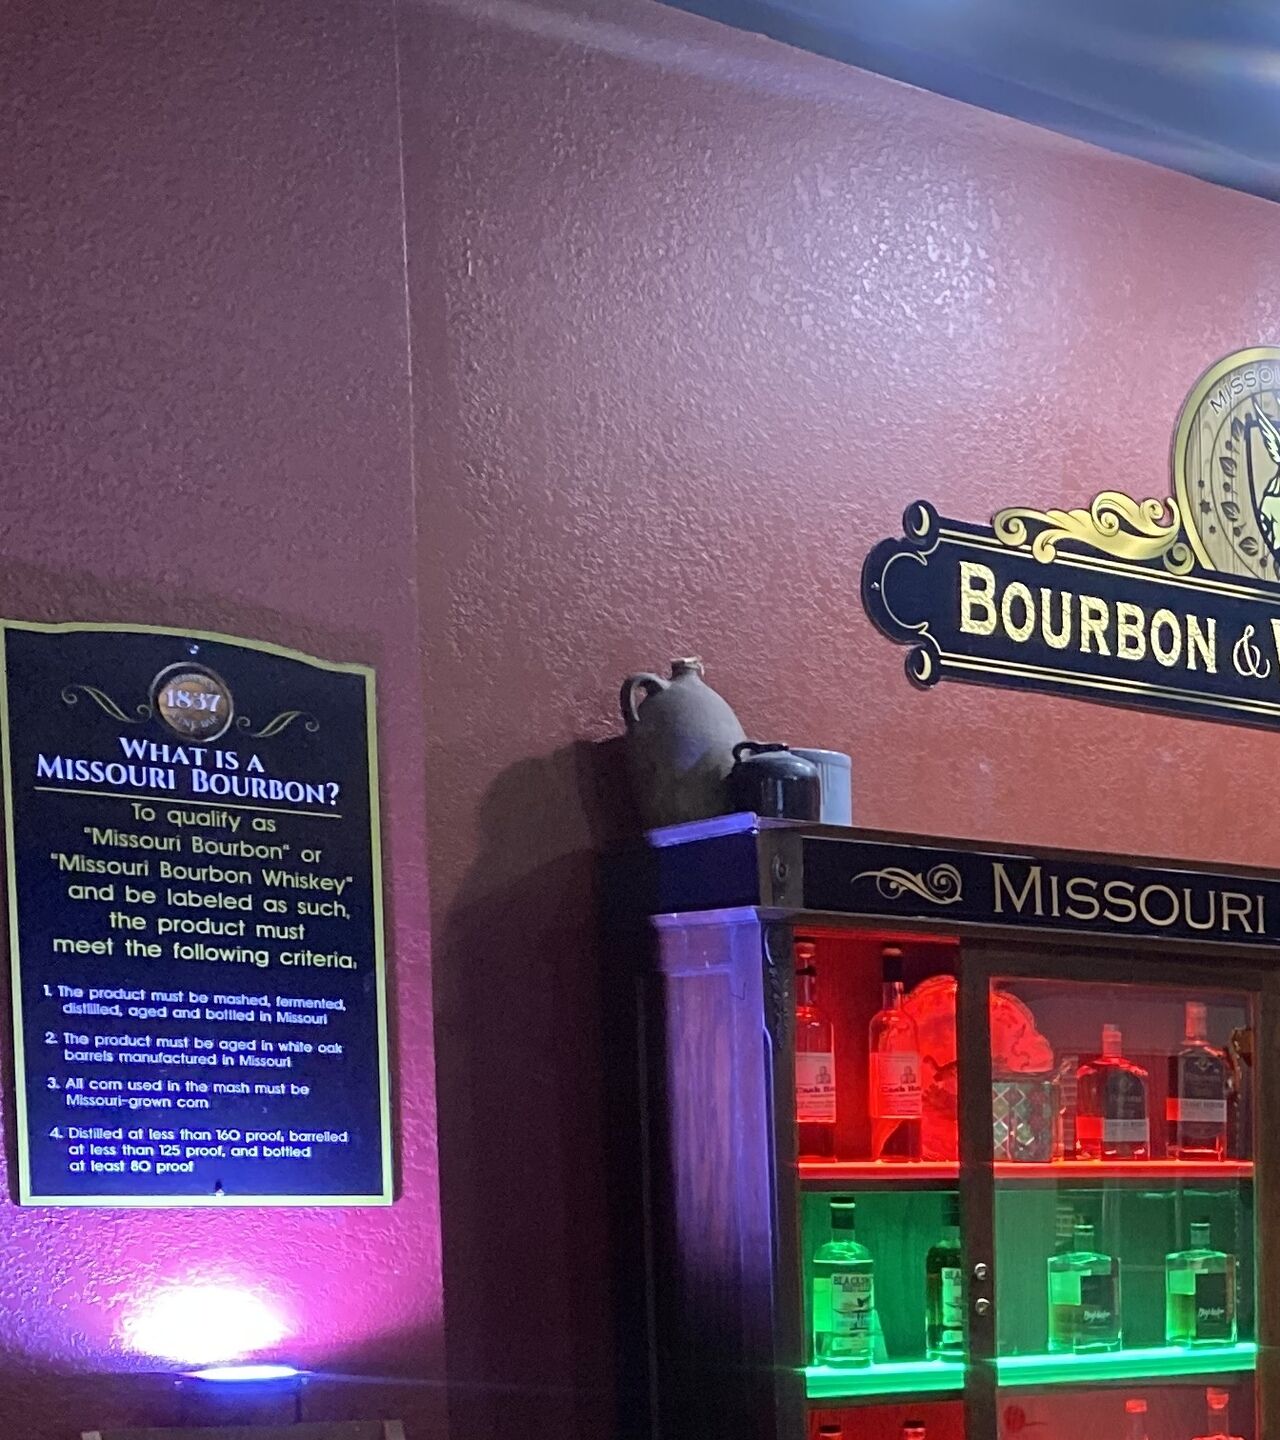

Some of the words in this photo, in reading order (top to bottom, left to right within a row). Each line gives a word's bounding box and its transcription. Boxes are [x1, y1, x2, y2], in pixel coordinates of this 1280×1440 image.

[958, 562, 1218, 676] BOURBON
[1231, 624, 1269, 681] &
[166, 688, 221, 713] 1837
[119, 736, 208, 767] WHAT
[216, 751, 239, 769] IS
[247, 754, 264, 773] A
[36, 754, 175, 790] MISSOURI
[192, 771, 339, 806] BOURBON?
[131, 802, 155, 821] To
[167, 810, 241, 832] qualify
[252, 817, 276, 832] as
[84, 826, 181, 852] "Missouri
[192, 836, 290, 860] Bourbon"
[301, 847, 322, 863] or
[51, 853, 149, 877] "Missouri
[161, 861, 252, 884] Bourbon
[262, 869, 353, 894] Whiskey"
[68, 884, 114, 900] and
[126, 886, 156, 904] be
[167, 889, 253, 911] labeled
[263, 897, 287, 913] as
[298, 897, 351, 919] such,
[992, 862, 1268, 935] MISSOURI
[109, 911, 146, 930] the
[158, 914, 245, 937] product
[256, 922, 305, 940] must
[53, 937, 113, 955] meet
[125, 940, 162, 958] the
[173, 942, 269, 968] following
[43, 984, 53, 997] 1.
[58, 985, 83, 998] The
[89, 988, 145, 1003] product
[151, 991, 182, 1003] must
[189, 991, 208, 1004] be
[213, 993, 271, 1009] mashed,
[276, 996, 347, 1012] fermented,
[62, 1001, 123, 1017] distilled,
[128, 1005, 167, 1020] aged
[172, 1006, 200, 1020] and
[205, 1007, 255, 1022] bottled
[259, 1010, 272, 1022] in
[276, 1011, 327, 1025] Missouri
[45, 1033, 58, 1045] 2.
[63, 1033, 89, 1045] The
[94, 1034, 151, 1050] product
[157, 1038, 189, 1050] must
[194, 1038, 213, 1051] be
[219, 1038, 255, 1053] aged
[262, 1040, 273, 1051] in
[278, 1041, 312, 1053] white
[318, 1042, 343, 1054] oak
[64, 1049, 114, 1064] barrels
[119, 1051, 217, 1066] manufactured
[222, 1053, 234, 1065] in
[239, 1054, 291, 1068] Missouri
[47, 1078, 60, 1090] 3.
[66, 1077, 84, 1091] All
[127, 1079, 162, 1092] used
[167, 1080, 180, 1092] in
[185, 1080, 207, 1093] the
[213, 1082, 249, 1095] mash
[255, 1082, 285, 1096] must
[291, 1083, 309, 1096] be
[66, 1094, 171, 1110] Missouri-grown
[49, 1128, 63, 1139] 4.
[68, 1126, 122, 1141] Distilled
[128, 1129, 144, 1141] at
[148, 1128, 174, 1141] less
[180, 1128, 211, 1141] than
[216, 1129, 241, 1142] 160
[289, 1129, 348, 1143] barrelled
[68, 1144, 84, 1156] at
[90, 1143, 116, 1156] less
[122, 1143, 154, 1156] than
[158, 1144, 181, 1156] 125
[231, 1145, 258, 1157] and
[263, 1145, 311, 1158] bottled
[69, 1161, 85, 1172] at
[90, 1161, 124, 1173] least
[131, 1161, 150, 1173] 80
[156, 1161, 194, 1174] proof
